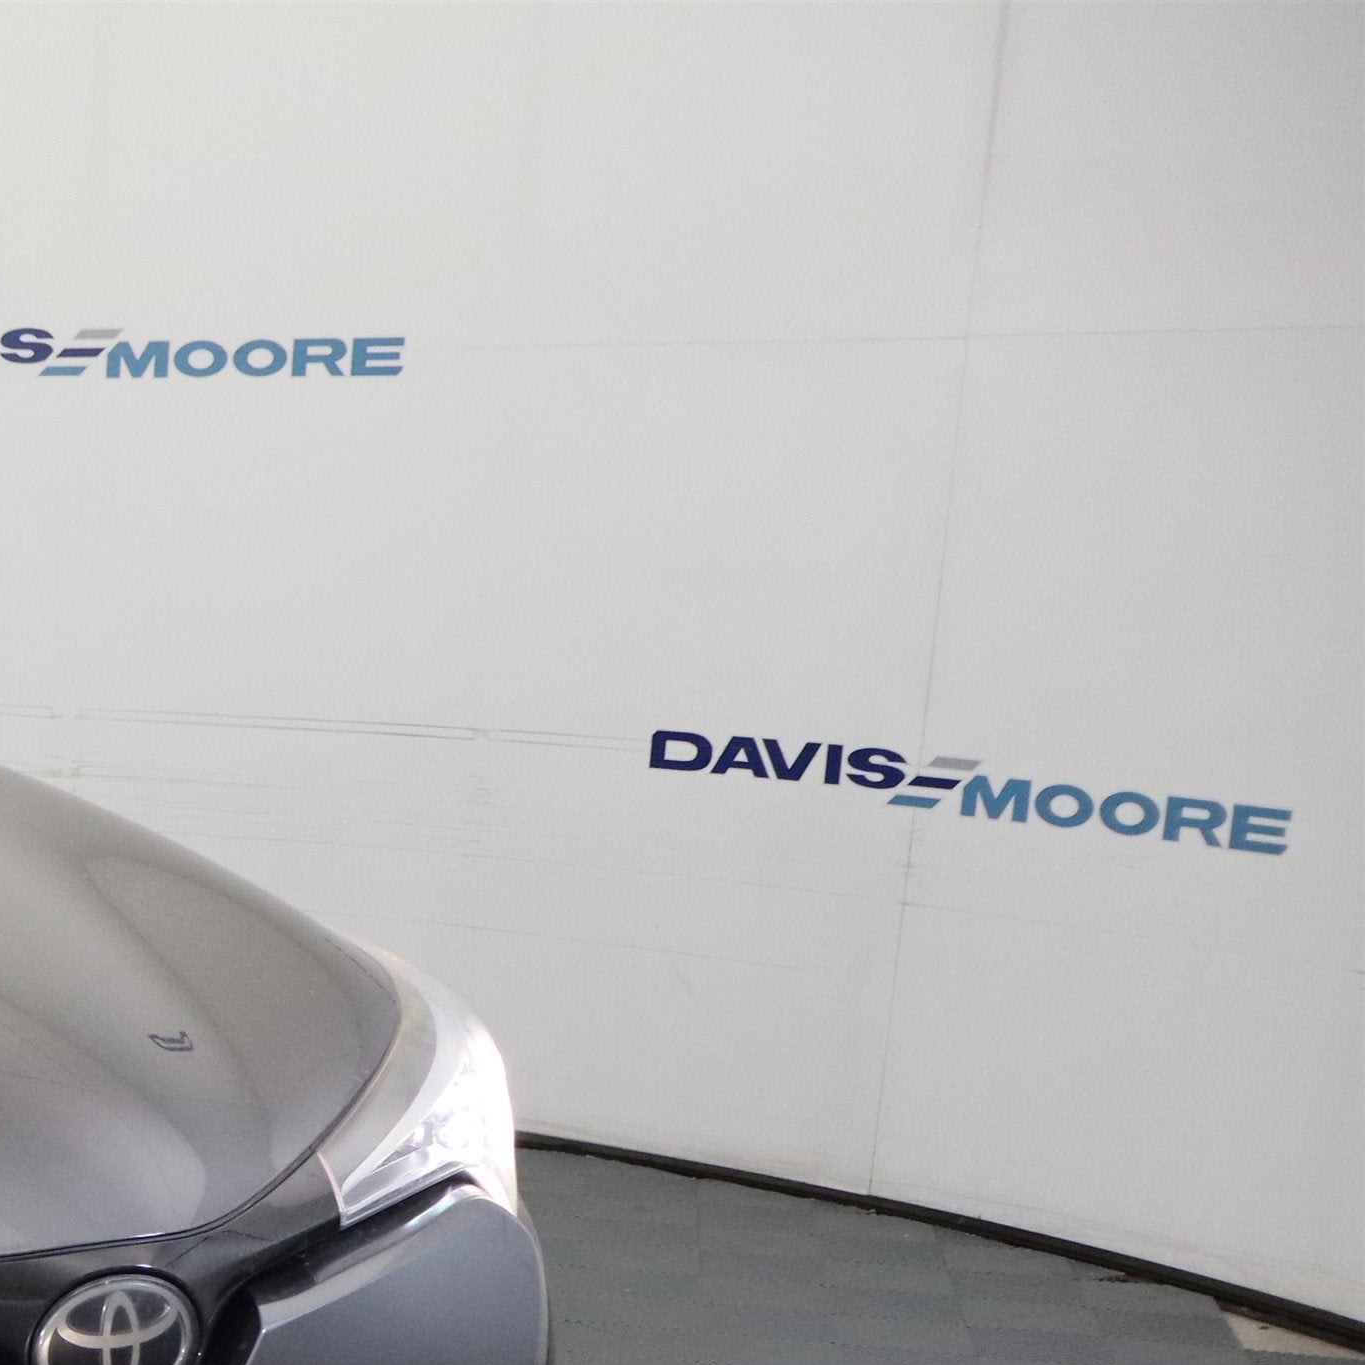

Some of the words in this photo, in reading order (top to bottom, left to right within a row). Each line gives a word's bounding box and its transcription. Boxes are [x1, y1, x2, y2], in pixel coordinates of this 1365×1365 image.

[105, 336, 406, 379] MOORE
[649, 729, 906, 790] DAVIS
[959, 774, 1294, 856] MOORE
